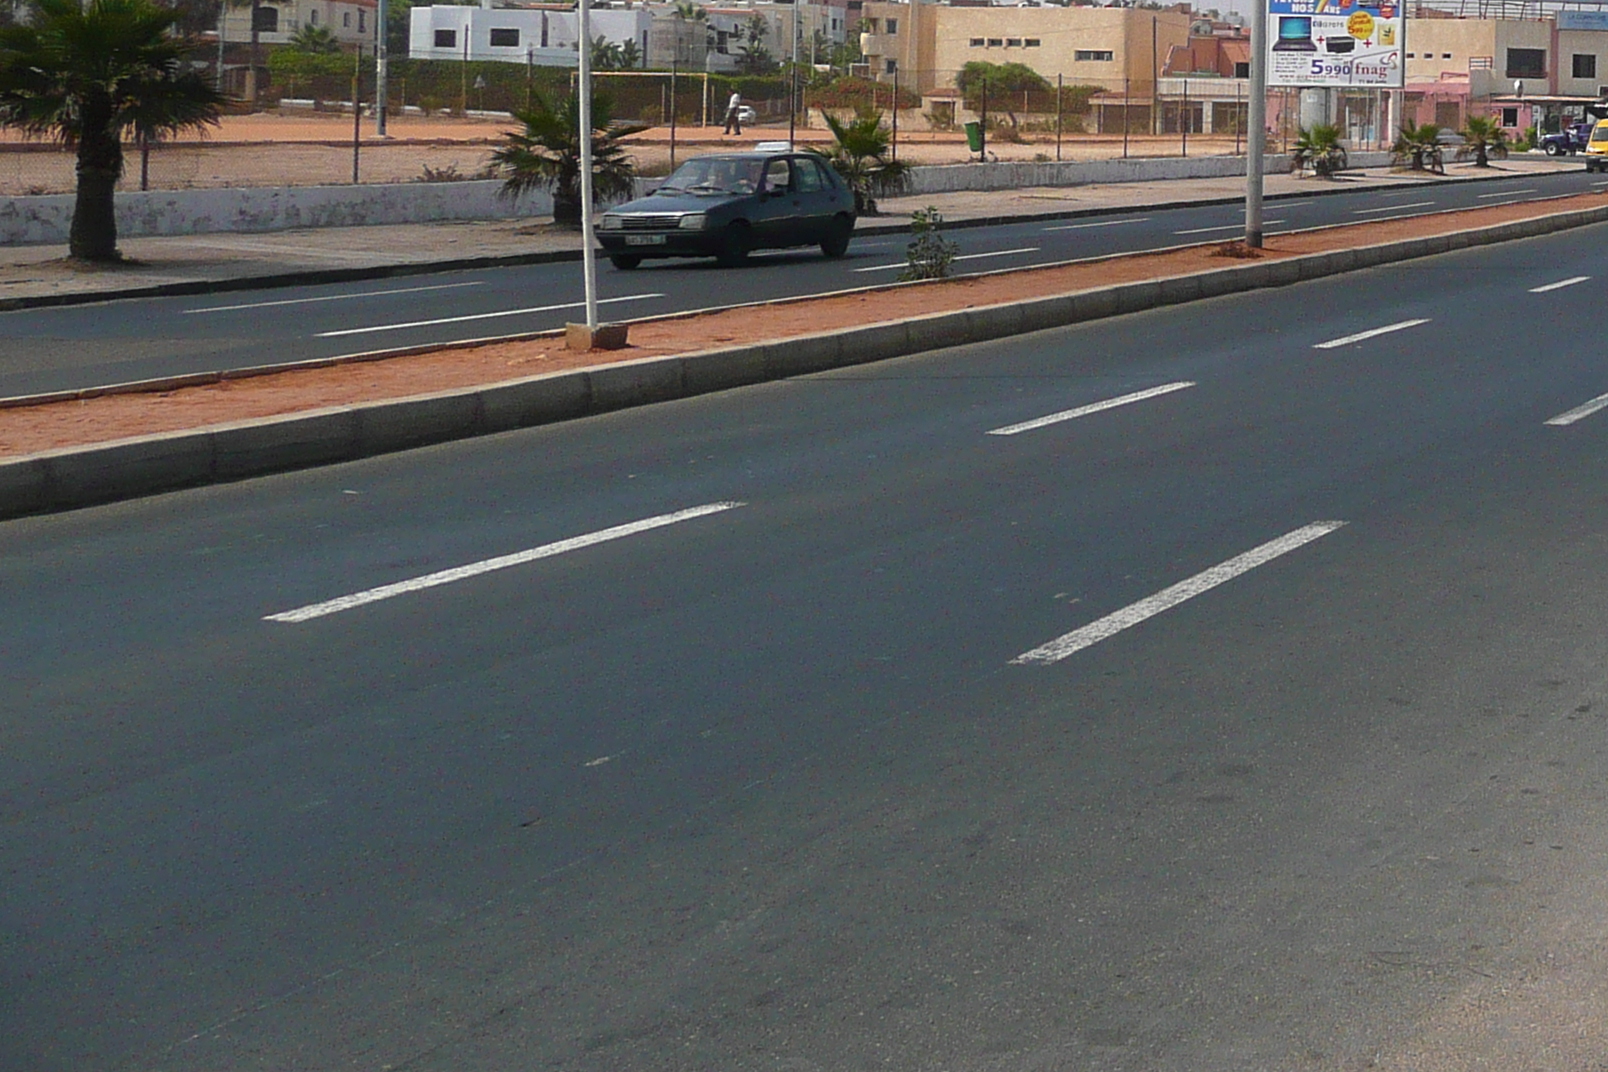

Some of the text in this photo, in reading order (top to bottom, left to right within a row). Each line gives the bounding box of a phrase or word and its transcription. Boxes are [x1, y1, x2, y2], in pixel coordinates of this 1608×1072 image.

[1291, 4, 1315, 13] NOS
[1323, 5, 1341, 15] ANS
[1311, 59, 1351, 75] 5990
